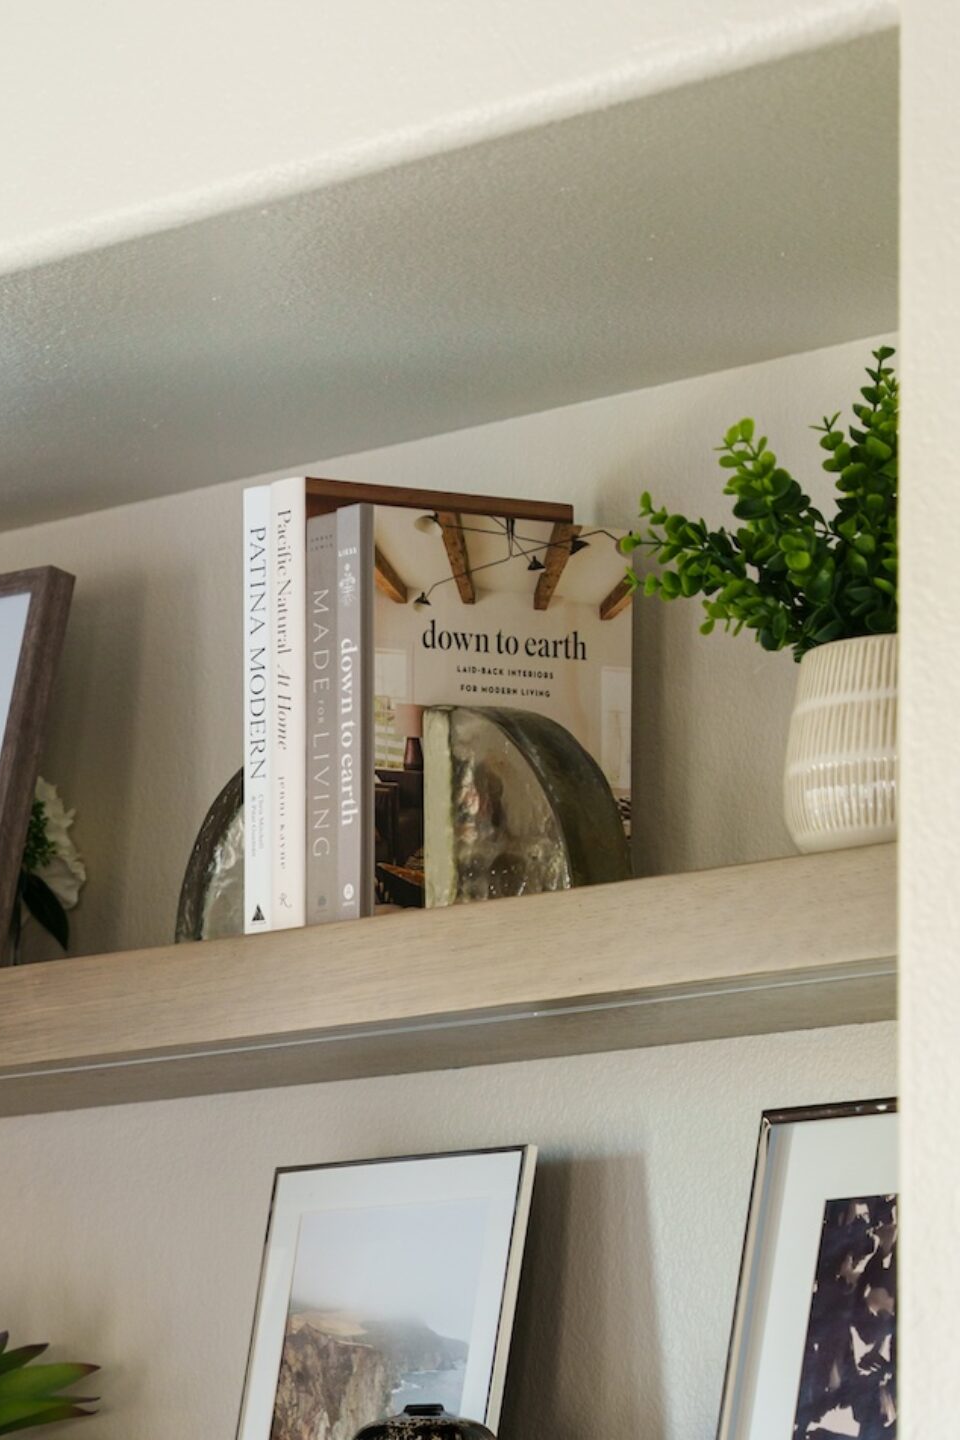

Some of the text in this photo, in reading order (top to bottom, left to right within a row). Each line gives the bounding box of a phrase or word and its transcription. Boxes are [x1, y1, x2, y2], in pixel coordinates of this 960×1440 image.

[277, 509, 292, 577] Pacific
[277, 578, 292, 654] Natural
[422, 618, 587, 661] down to earth
[249, 527, 266, 779] PATINA MODERN
[456, 665, 554, 680] LAID-BACK INTERIORS
[277, 694, 292, 750] Home
[312, 588, 331, 857] MADE FOR LIVING
[460, 683, 551, 698] FOR MODERN LIVING
[341, 637, 359, 827] down to earth
